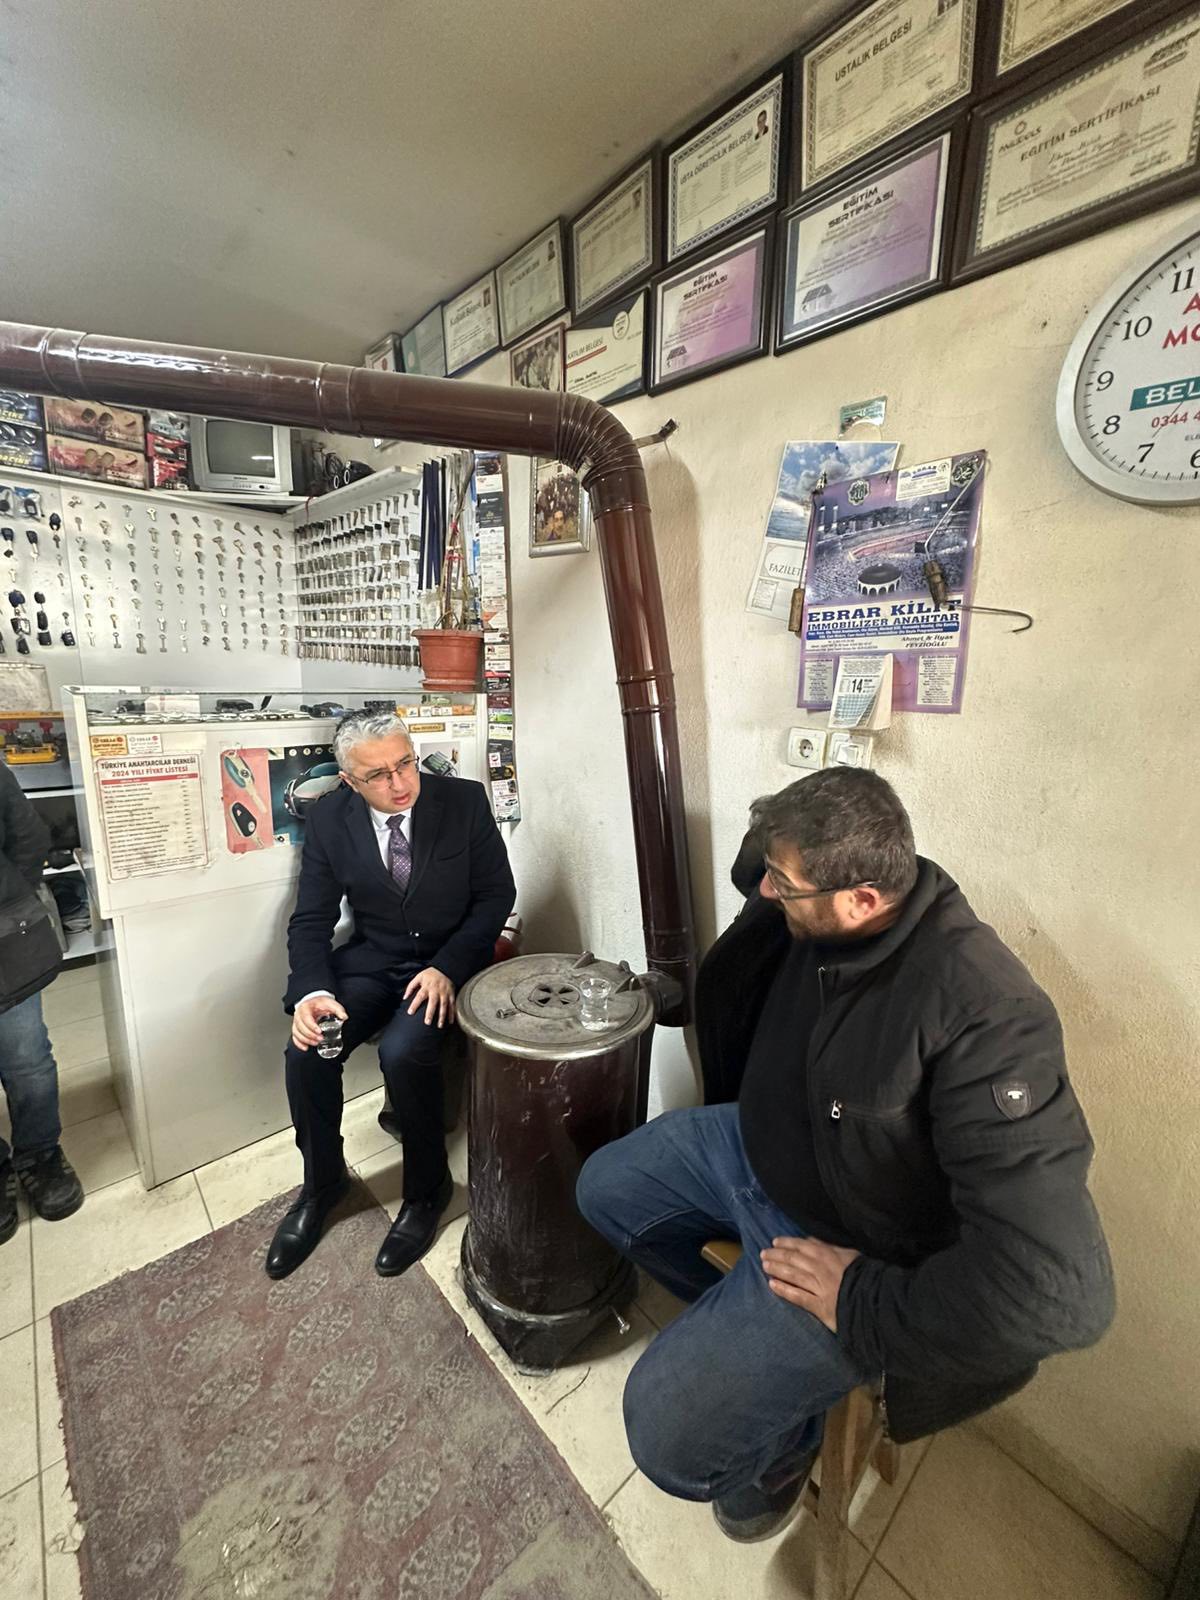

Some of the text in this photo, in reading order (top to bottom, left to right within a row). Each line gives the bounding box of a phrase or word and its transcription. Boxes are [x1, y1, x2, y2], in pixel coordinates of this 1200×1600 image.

[834, 49, 871, 82] USTALIK
[872, 17, 912, 56] BELGESİ
[843, 186, 878, 211] EĞİTİM
[1170, 266, 1195, 294] 11
[1123, 316, 1153, 341] 10
[1096, 370, 1115, 392] 9
[1102, 415, 1121, 435] 8
[1151, 411, 1189, 429] 0344
[1137, 442, 1155, 464] 7
[807, 607, 881, 623] EBRAR
[893, 613, 959, 626] ANAHTAR
[852, 678, 863, 693] 14
[101, 756, 196, 770] TÜRKİYE ANAHTARCILAR DERNEĞİ
